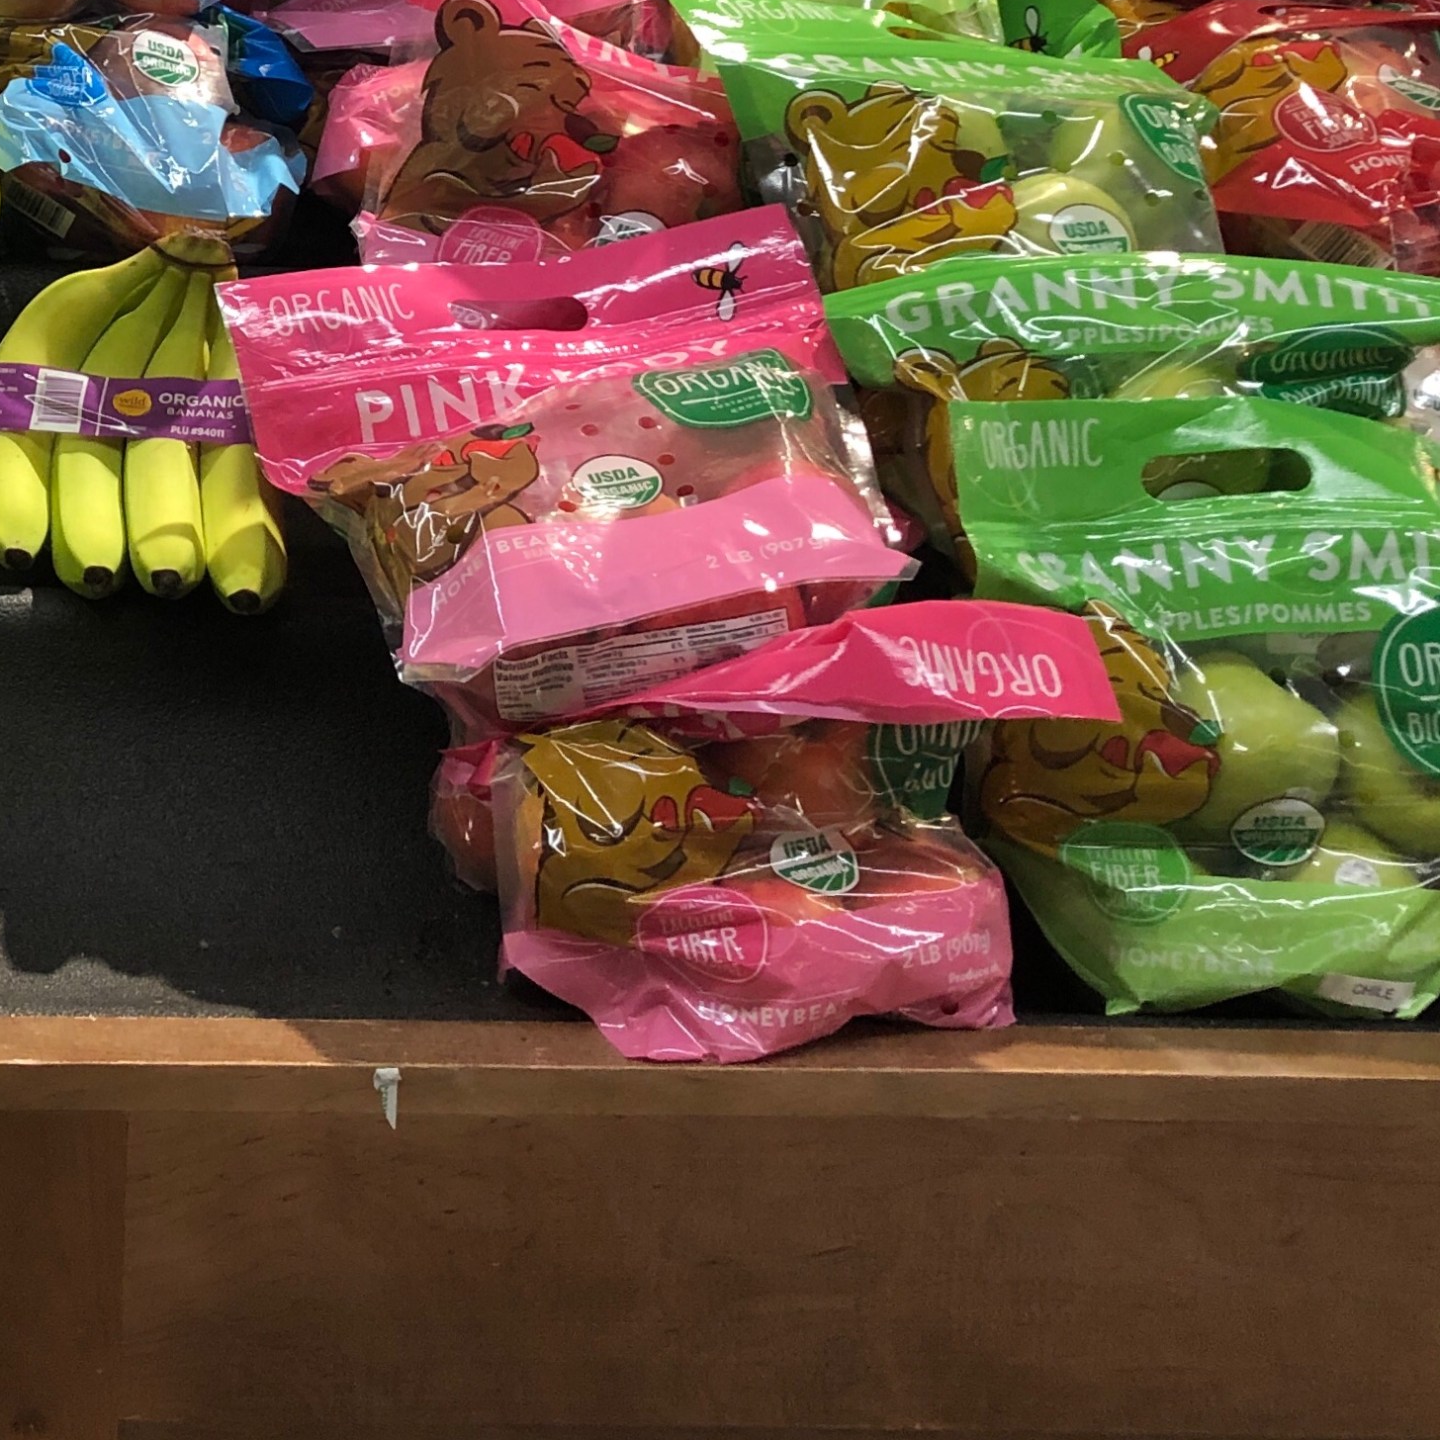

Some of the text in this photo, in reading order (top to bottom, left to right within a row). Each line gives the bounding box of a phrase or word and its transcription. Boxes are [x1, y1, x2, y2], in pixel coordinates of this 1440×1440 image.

[146, 38, 185, 62] USDA
[1063, 221, 1110, 239] USDA
[267, 283, 415, 338] ORGANIC
[885, 265, 1179, 333] GRANNY
[158, 392, 245, 409] ORGANIC
[166, 407, 235, 420] BANANAS
[355, 367, 525, 444] PINK
[170, 424, 226, 438] PLU #94011
[980, 418, 1103, 471] ORGANIC
[588, 466, 640, 484] USDA
[1017, 531, 1430, 596] GRANNY SMI
[1159, 600, 1372, 633] PPLES/POMMES
[899, 635, 1061, 700] ORGANIC
[783, 833, 832, 857] USDA
